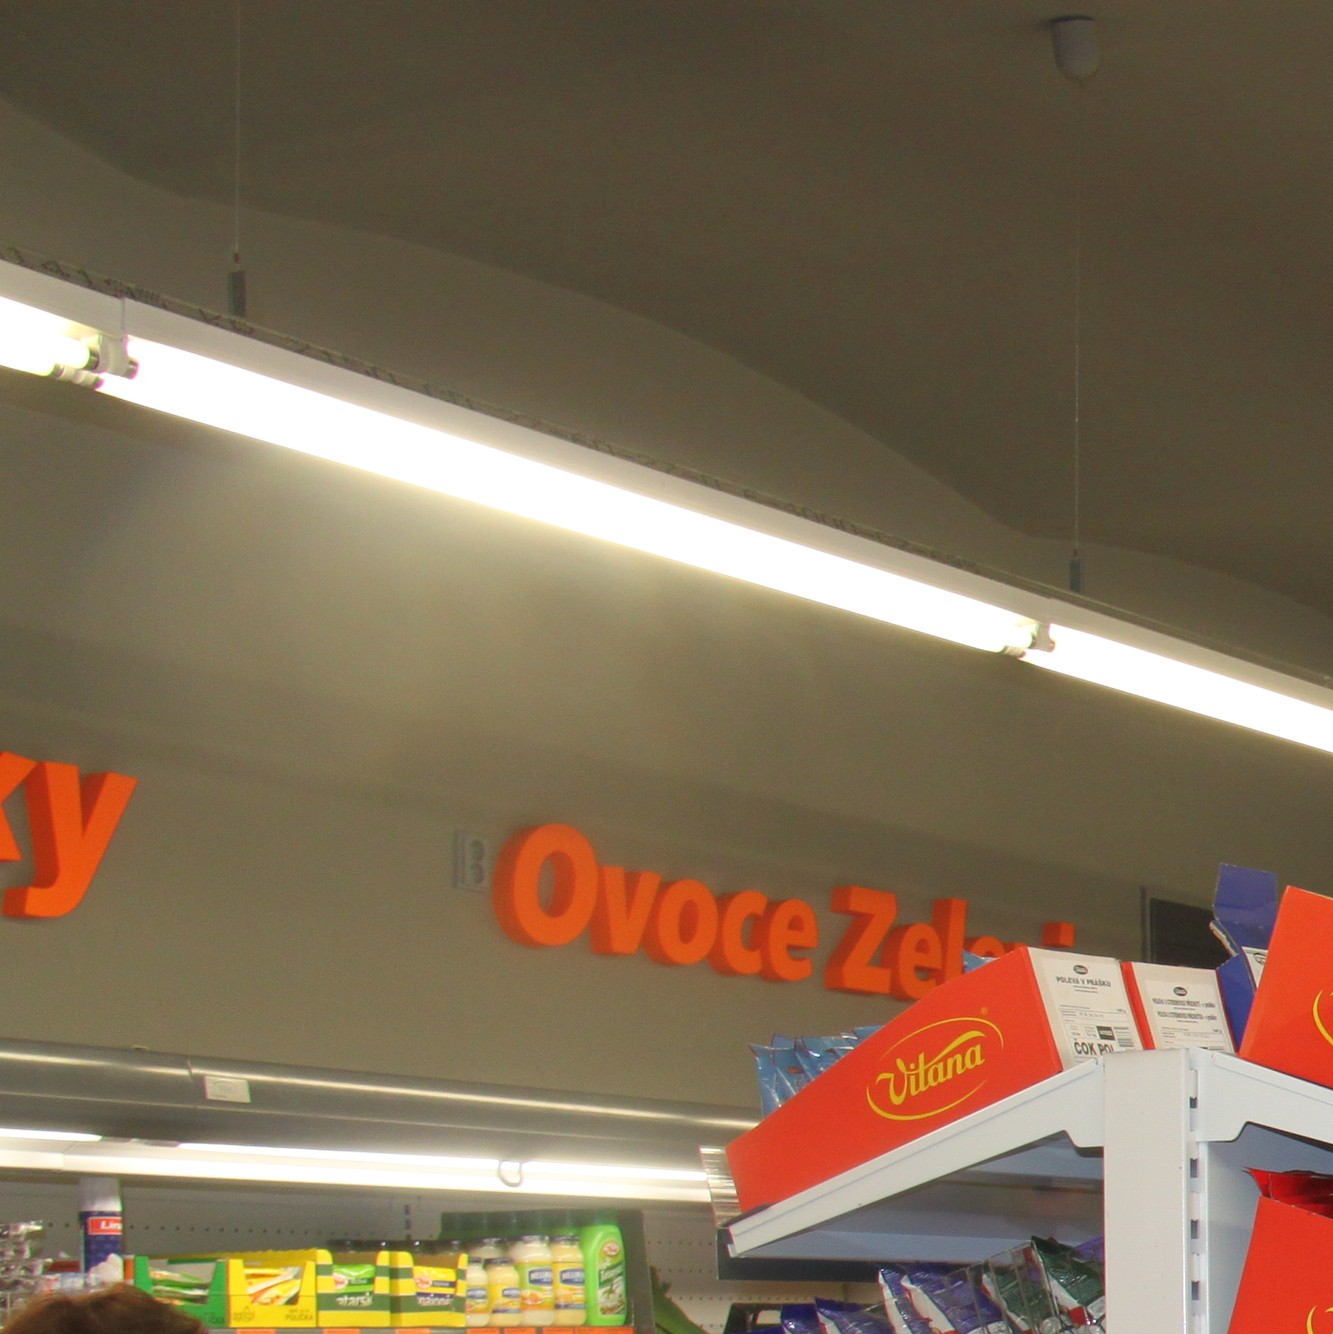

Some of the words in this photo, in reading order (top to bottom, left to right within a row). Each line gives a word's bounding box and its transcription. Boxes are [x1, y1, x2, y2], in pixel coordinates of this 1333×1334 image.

[492, 823, 818, 982] Ovoce
[825, 885, 1076, 1000] Zel
[876, 1030, 987, 1108] Vitana
